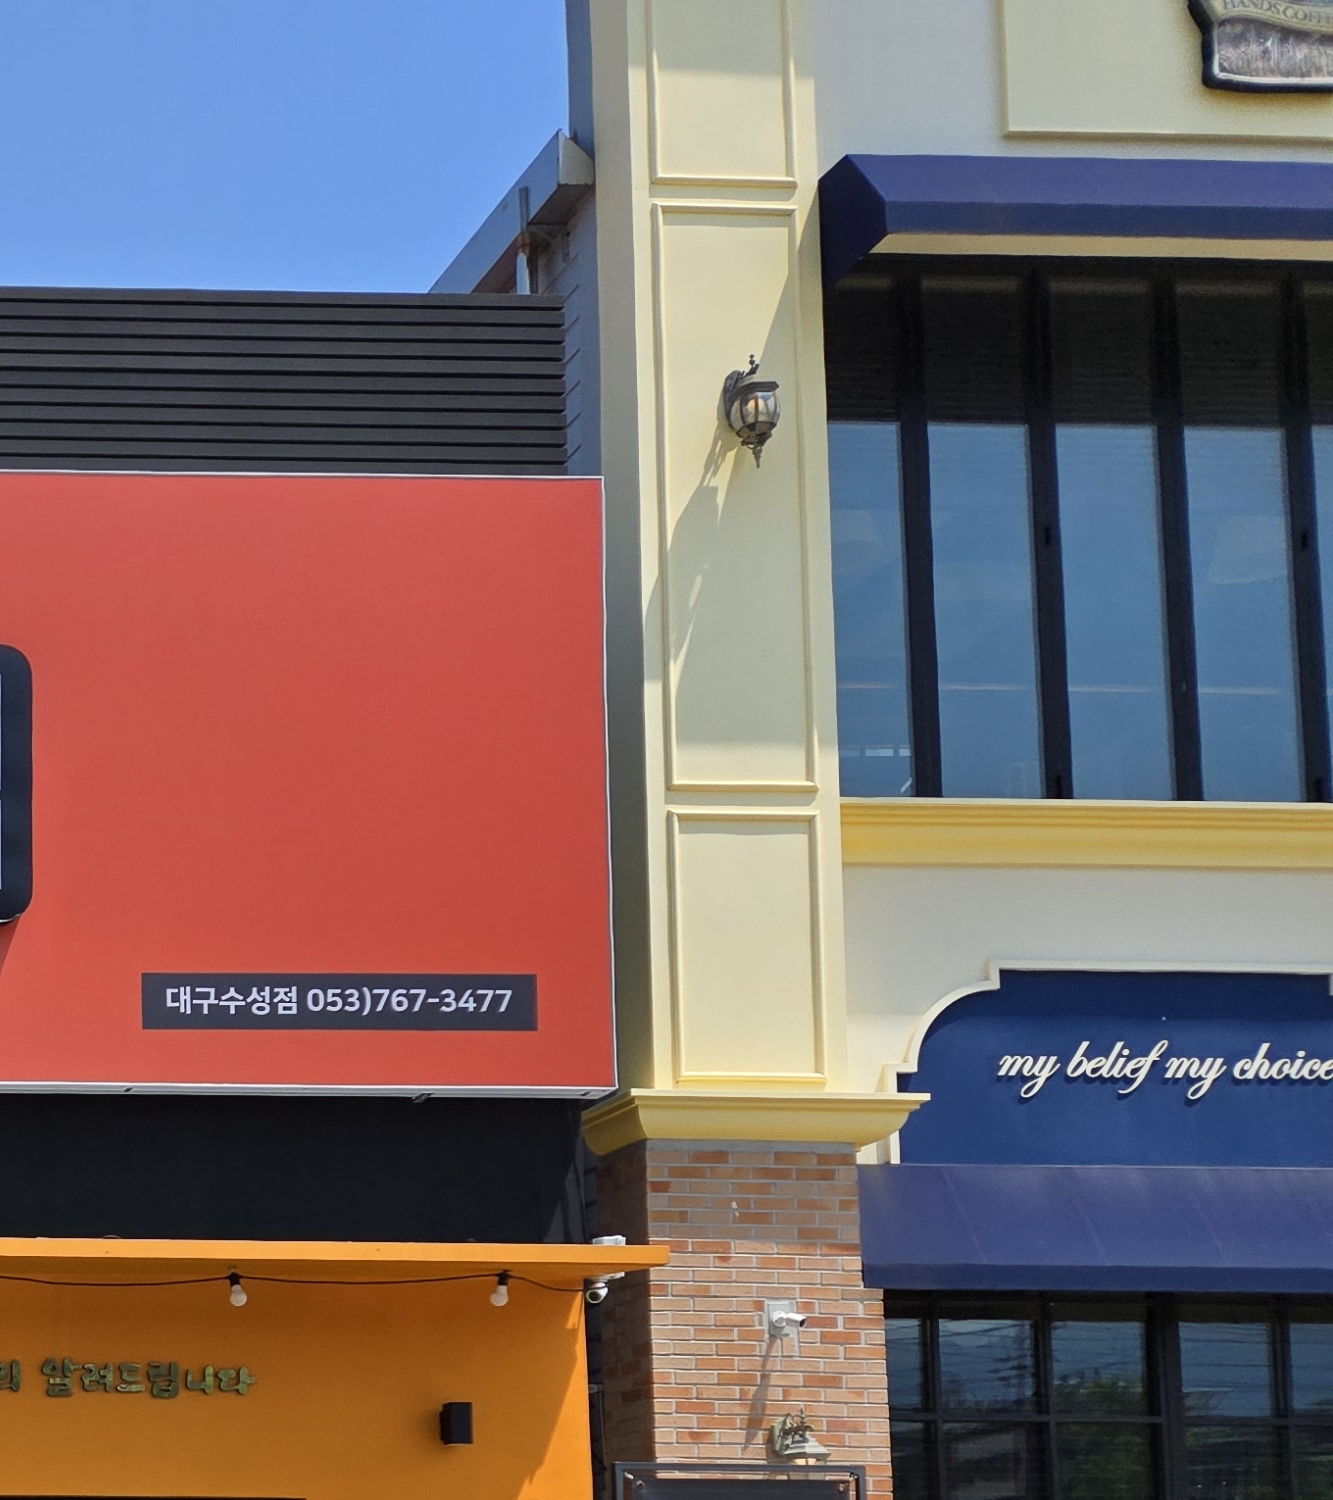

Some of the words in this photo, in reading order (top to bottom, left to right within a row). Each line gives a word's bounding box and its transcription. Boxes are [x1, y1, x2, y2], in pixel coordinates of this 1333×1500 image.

[165, 986, 298, 1015] 대구수성점
[307, 988, 513, 1016] 053)767-3477
[997, 1053, 1061, 1098] my
[1066, 1040, 1169, 1094] belief
[1164, 1055, 1227, 1099] my
[1233, 1042, 1333, 1080] choice
[39, 1355, 258, 1400] 알려드립니다
